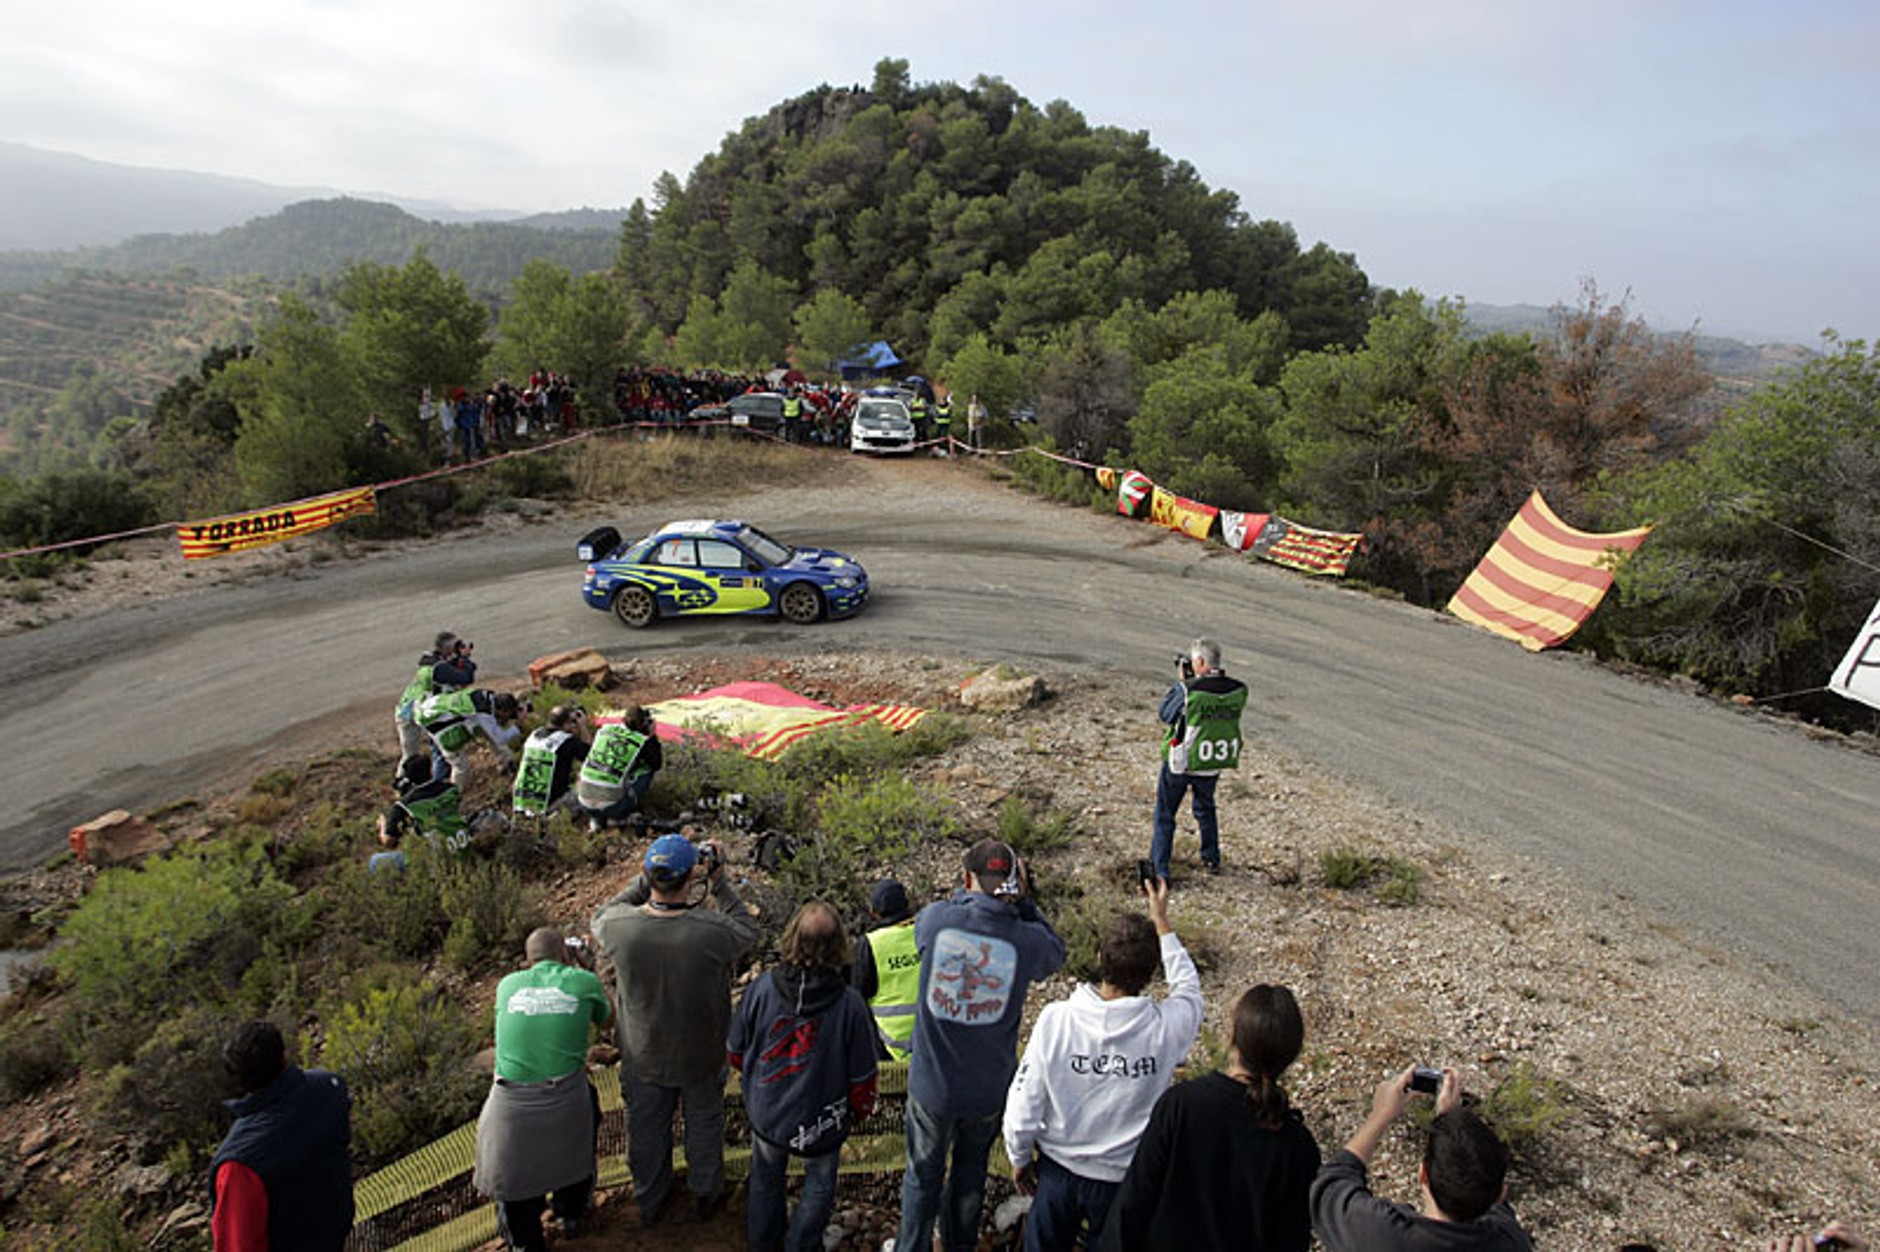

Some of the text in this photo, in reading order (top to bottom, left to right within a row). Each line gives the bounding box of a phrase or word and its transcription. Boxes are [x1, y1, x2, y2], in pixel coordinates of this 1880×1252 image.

[190, 511, 296, 541] TORRADA
[1199, 737, 1239, 761] 031
[1071, 1054, 1157, 1079] TEAM
